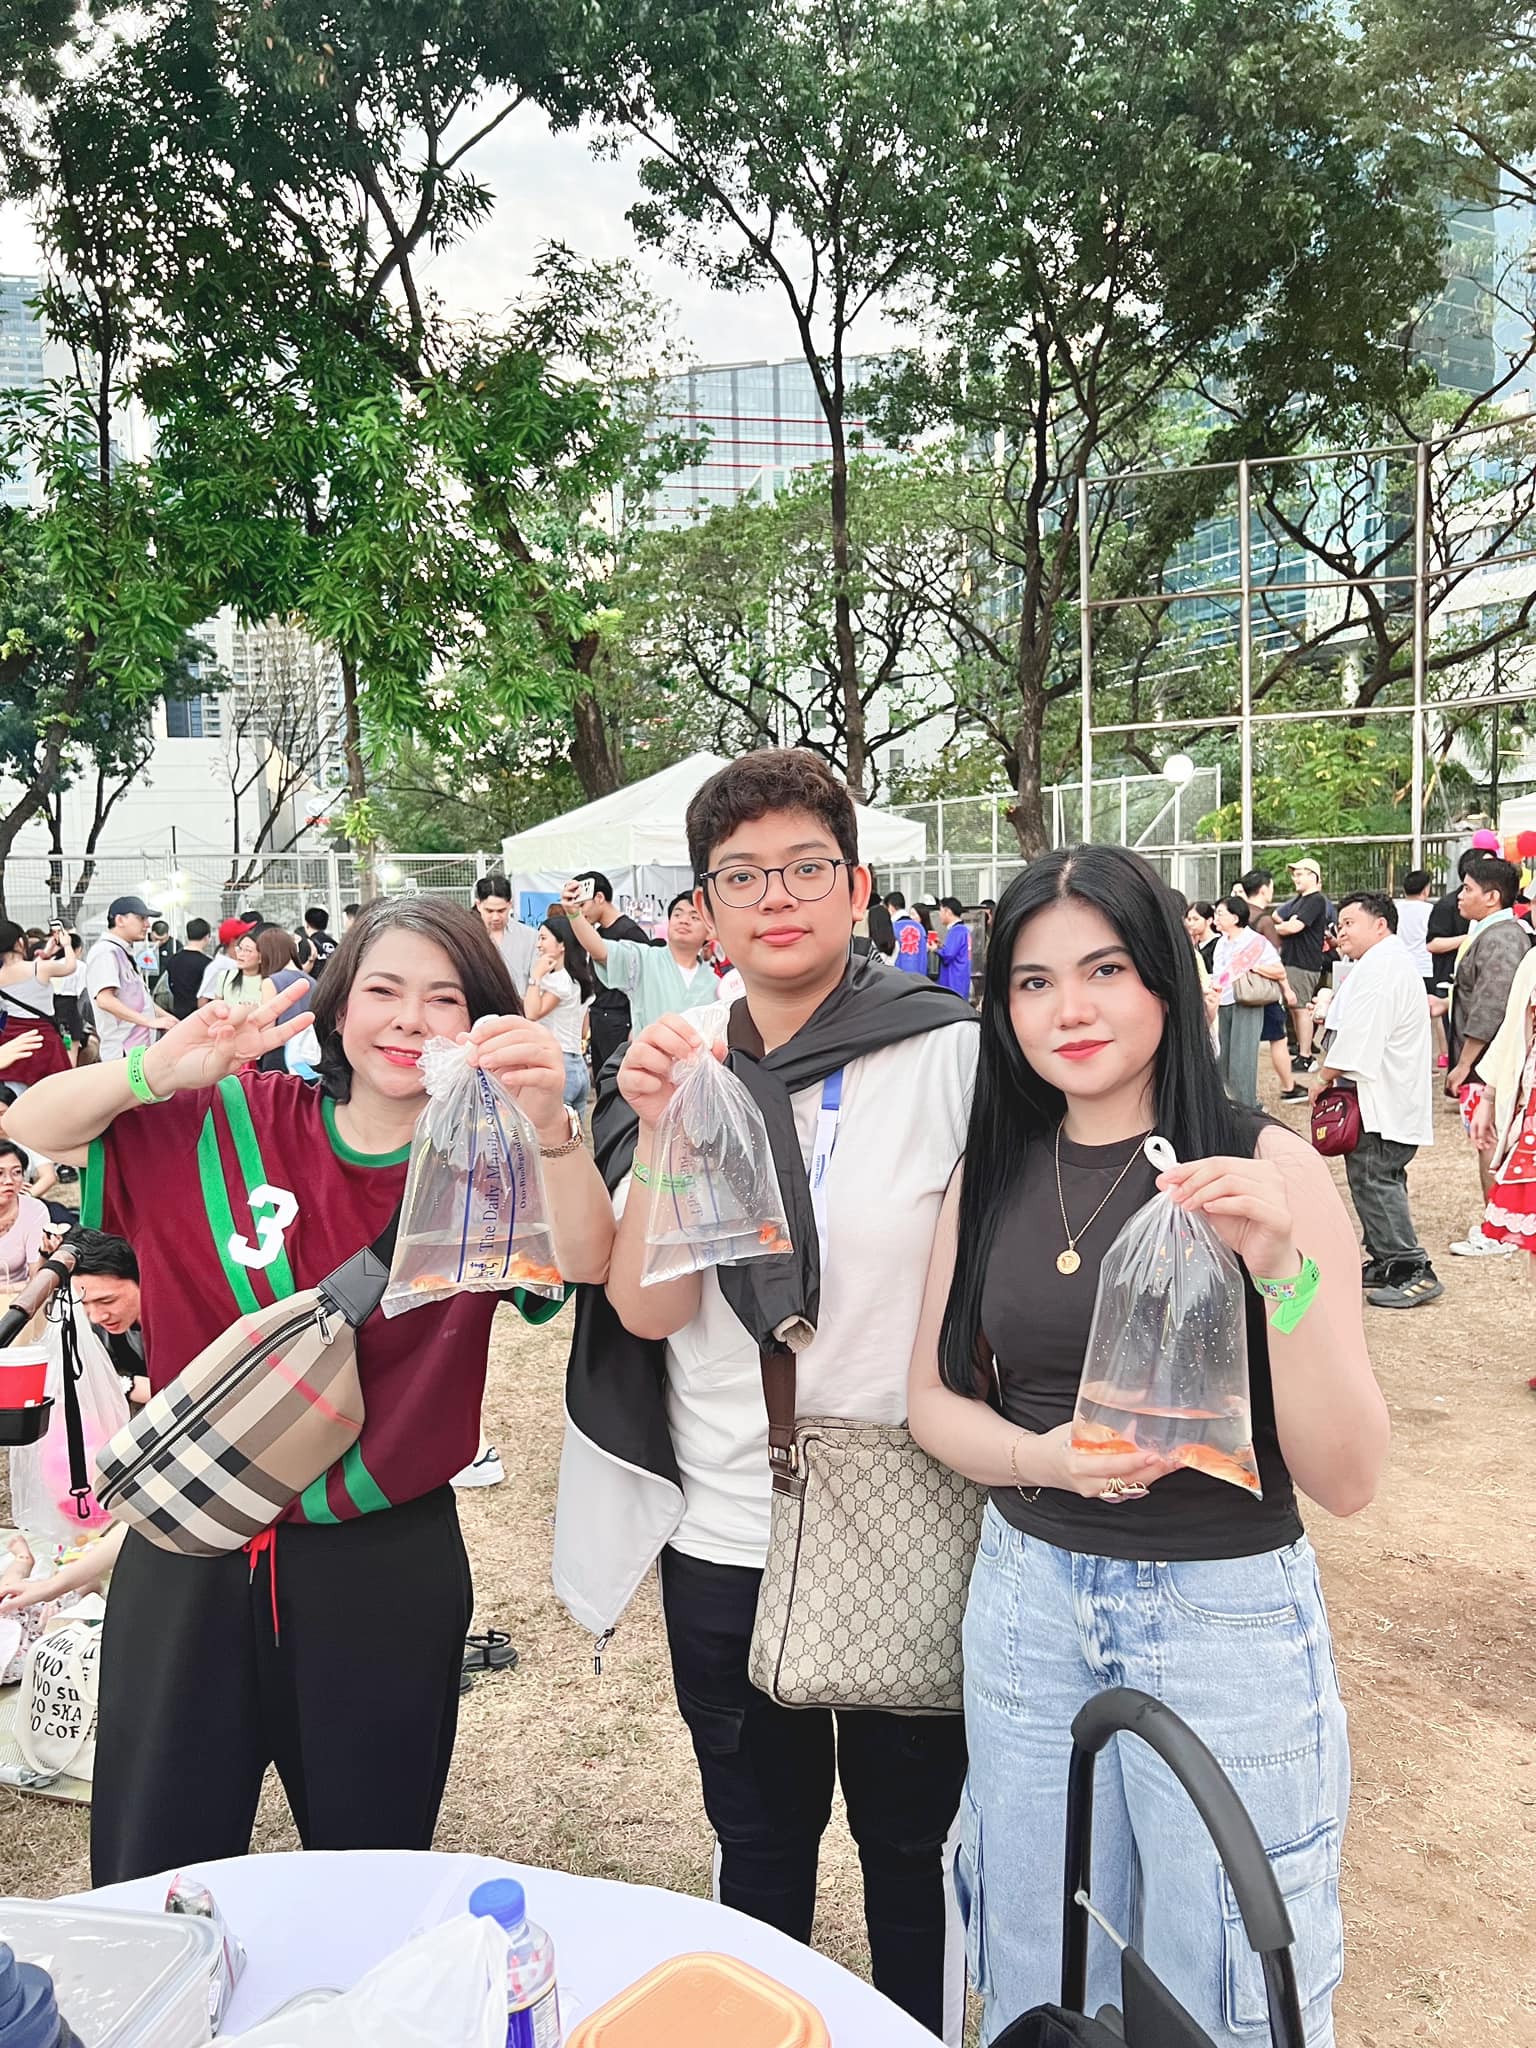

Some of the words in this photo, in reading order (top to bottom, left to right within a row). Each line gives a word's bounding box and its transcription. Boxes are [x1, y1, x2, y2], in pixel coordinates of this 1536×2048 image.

[619, 894, 667, 917] Dily
[483, 1184, 503, 1221] Daily
[227, 1184, 299, 1270] 3
[479, 1226, 496, 1252] The
